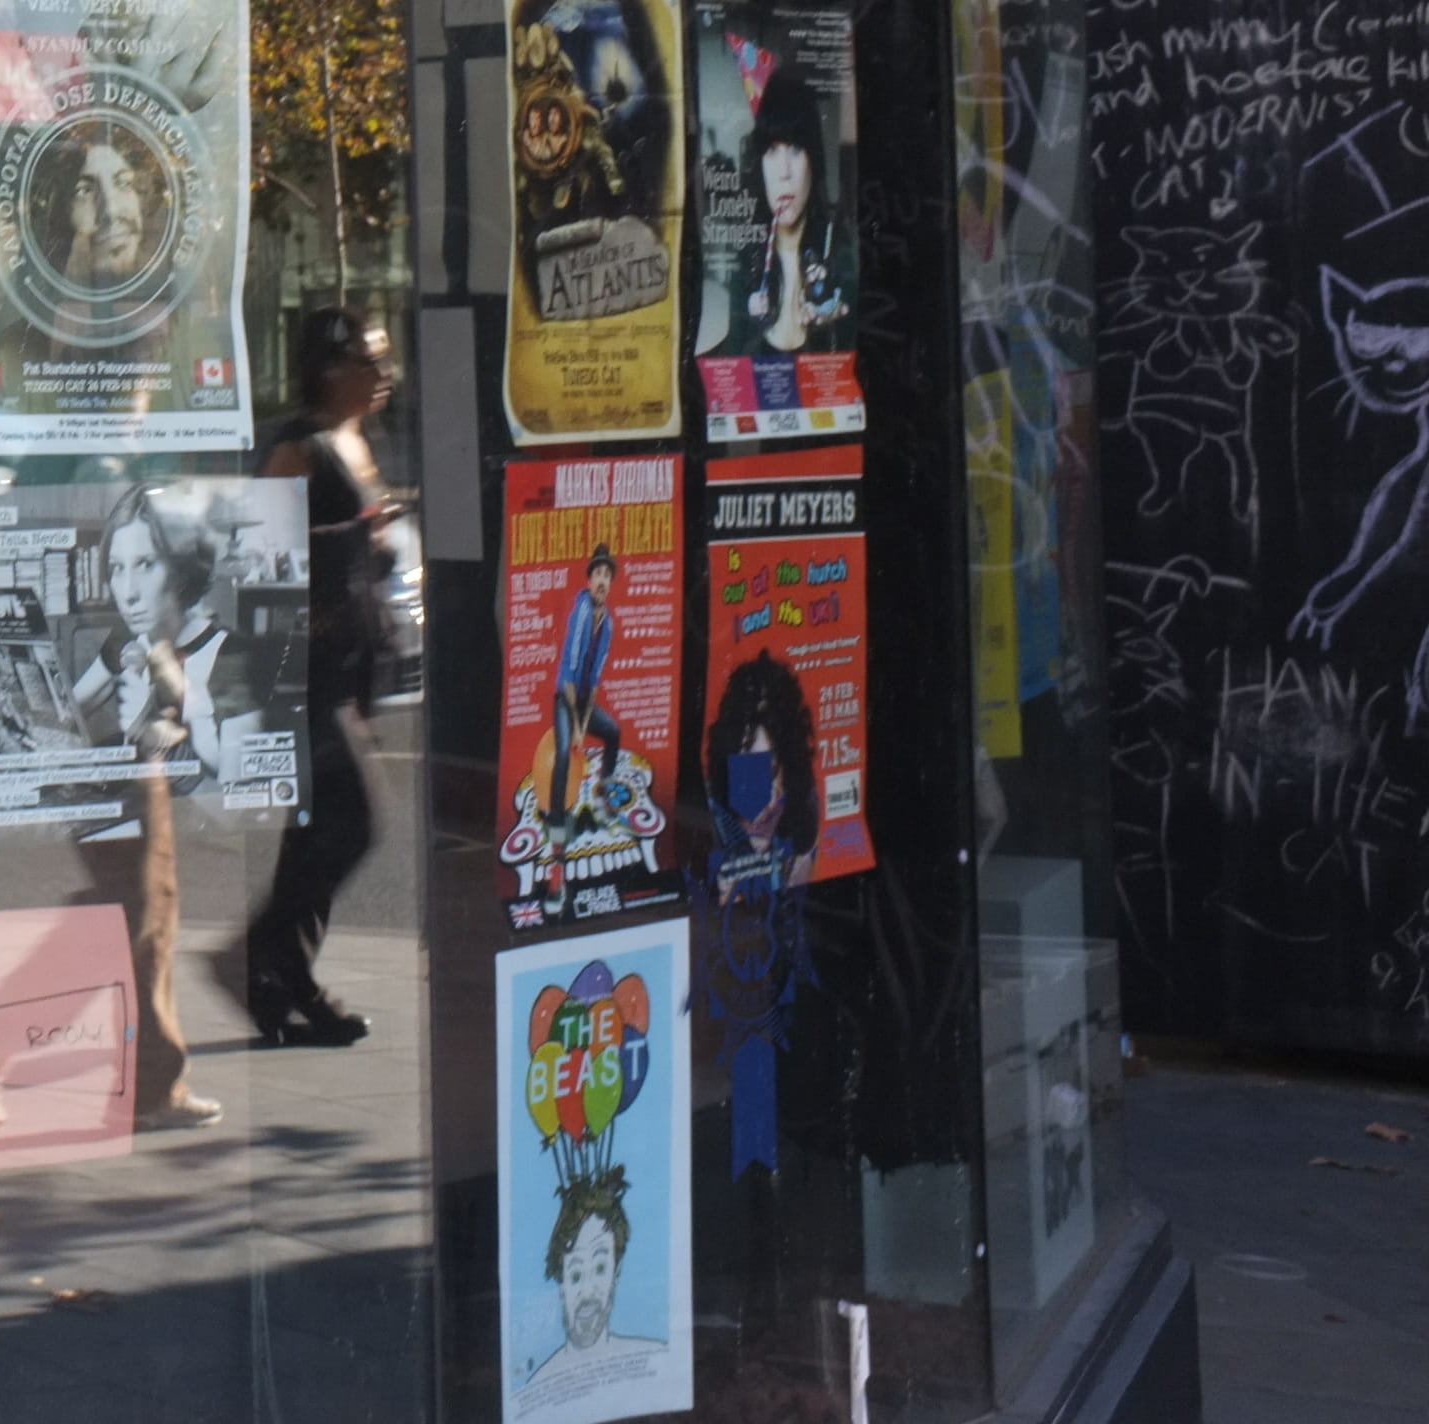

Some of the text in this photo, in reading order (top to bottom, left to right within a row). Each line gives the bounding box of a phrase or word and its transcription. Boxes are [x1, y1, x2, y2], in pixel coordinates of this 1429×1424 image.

[702, 219, 768, 251] Strangers
[546, 253, 666, 314] ATLANTIS
[714, 490, 857, 529] JULIET MEYERS
[776, 560, 801, 585] the
[807, 554, 848, 585] hutch
[778, 599, 803, 627] the
[559, 1006, 614, 1051] THE
[530, 1037, 646, 1105] BEAST
